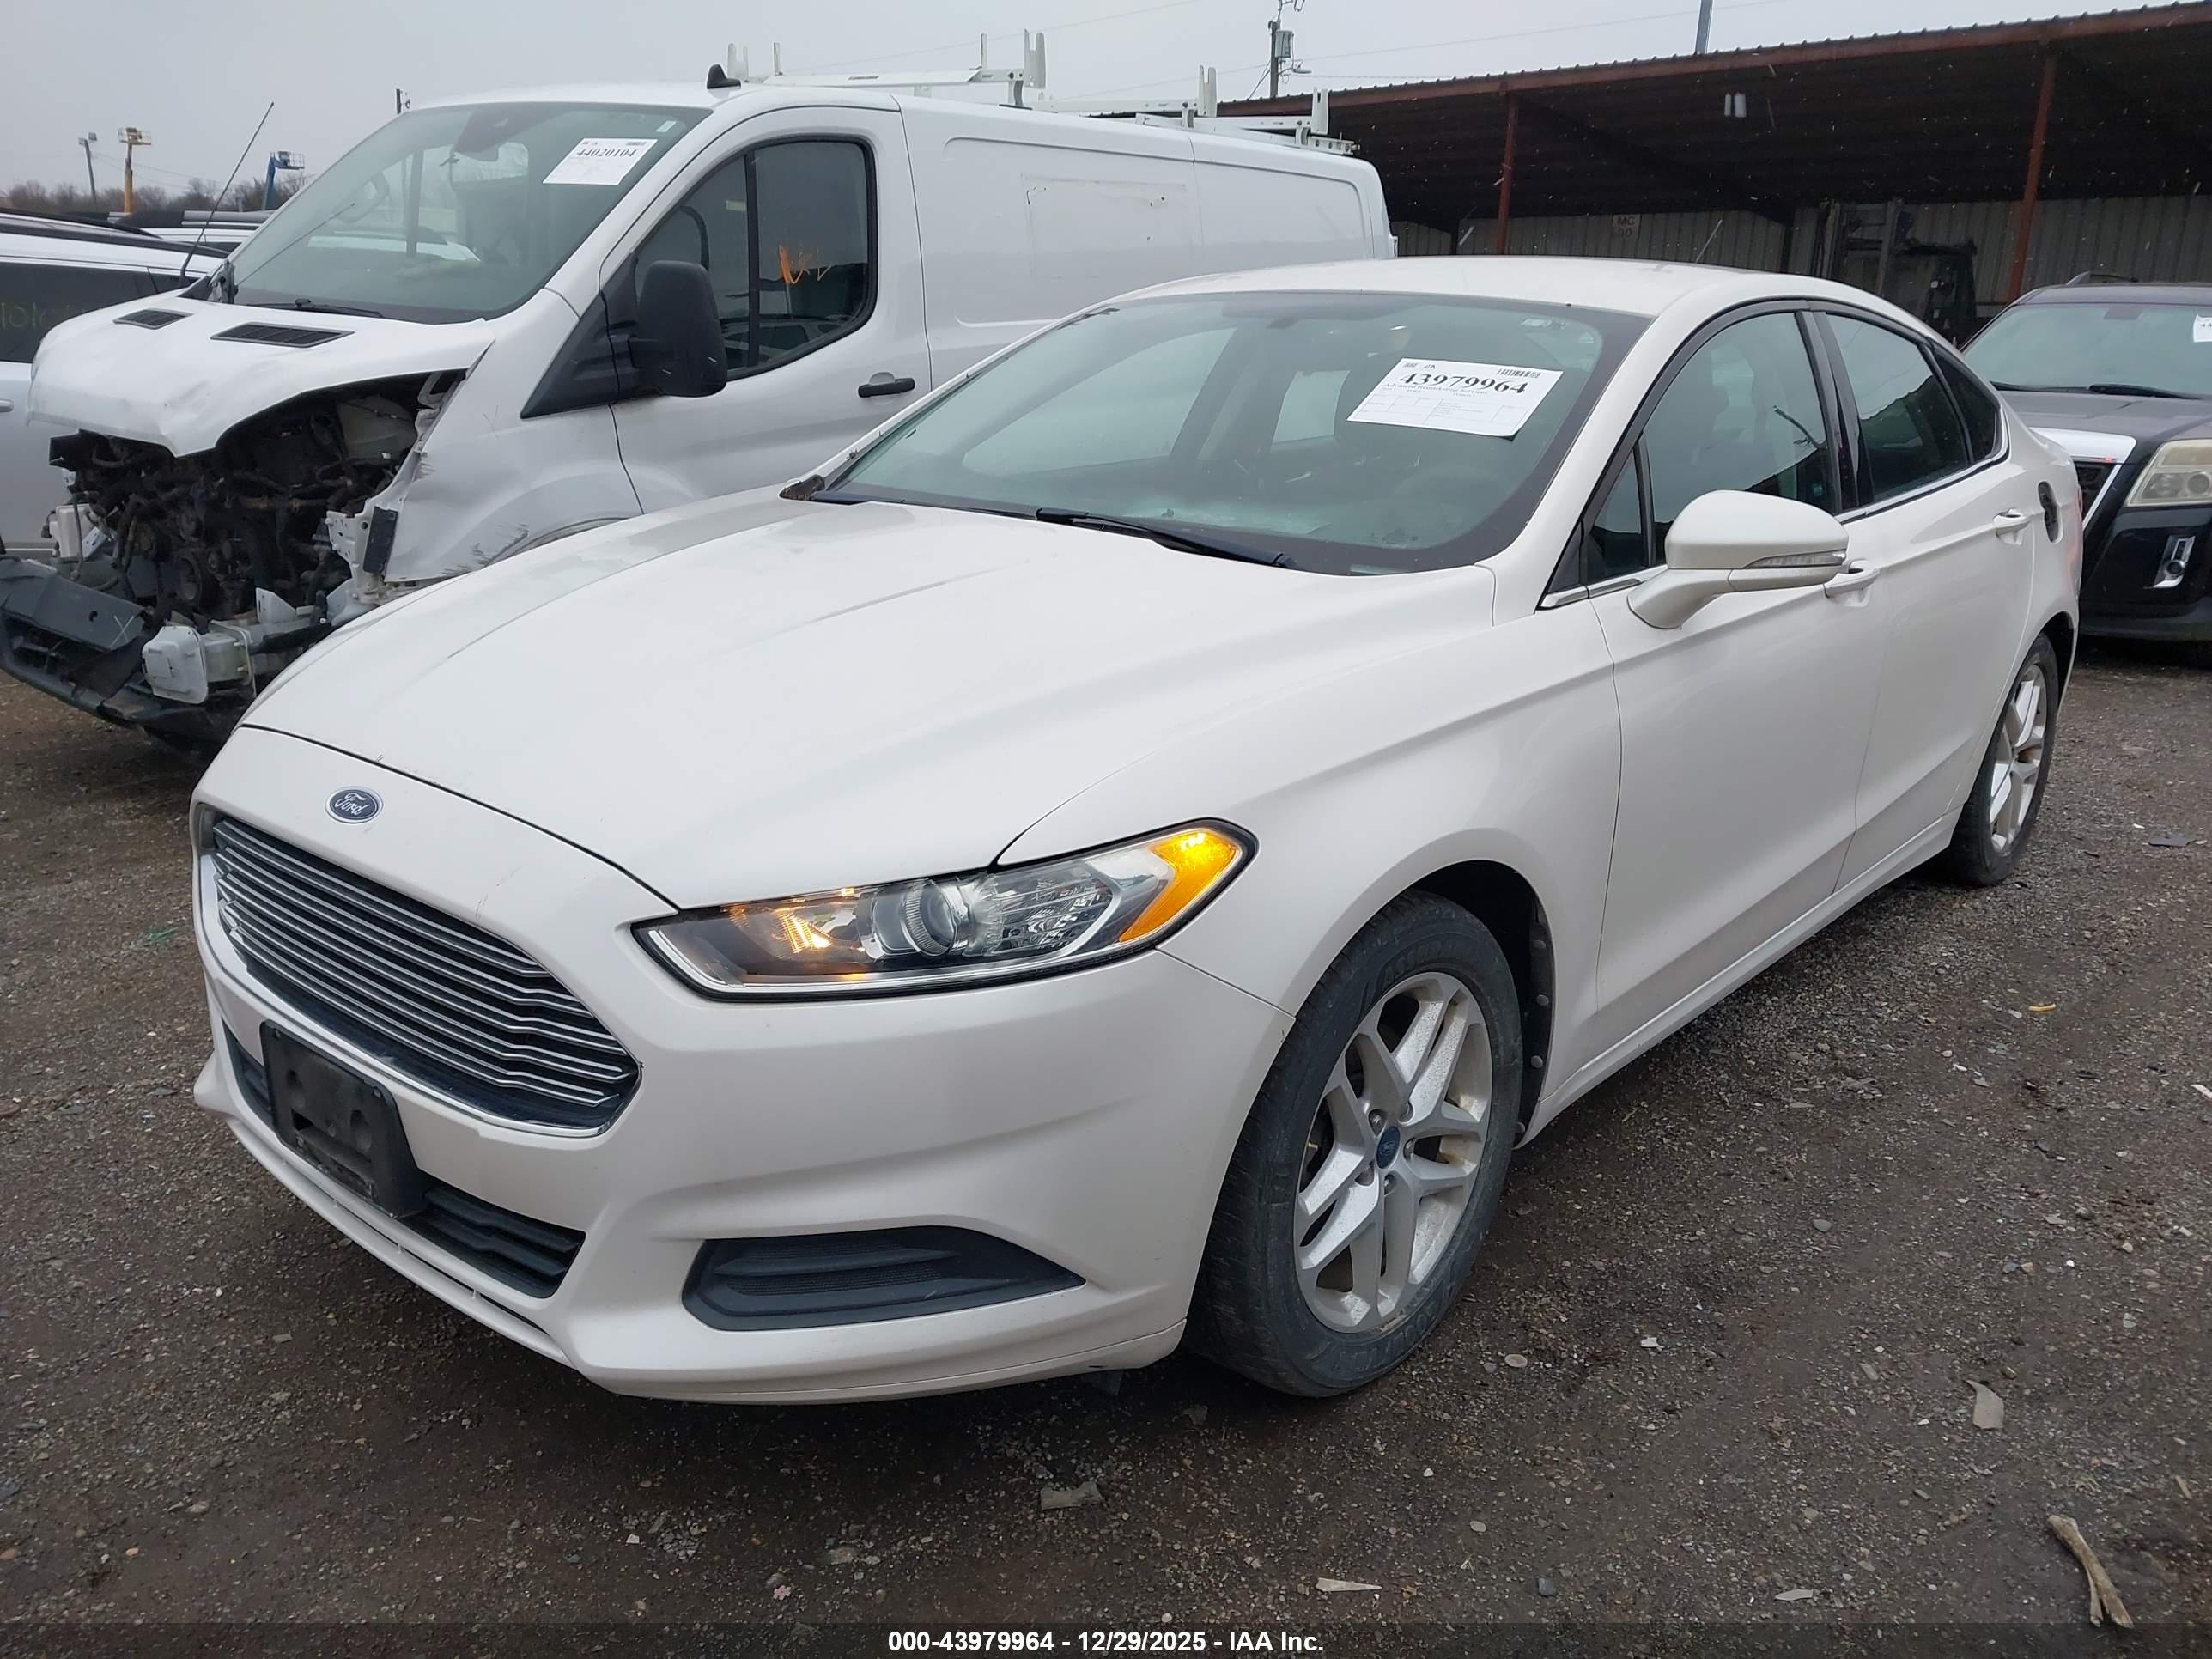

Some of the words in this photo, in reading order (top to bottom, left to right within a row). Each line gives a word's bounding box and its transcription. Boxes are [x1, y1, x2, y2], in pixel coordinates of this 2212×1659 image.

[577, 148, 637, 157] 44020104
[1400, 371, 1529, 395] 43979964
[334, 792, 370, 816] Ford
